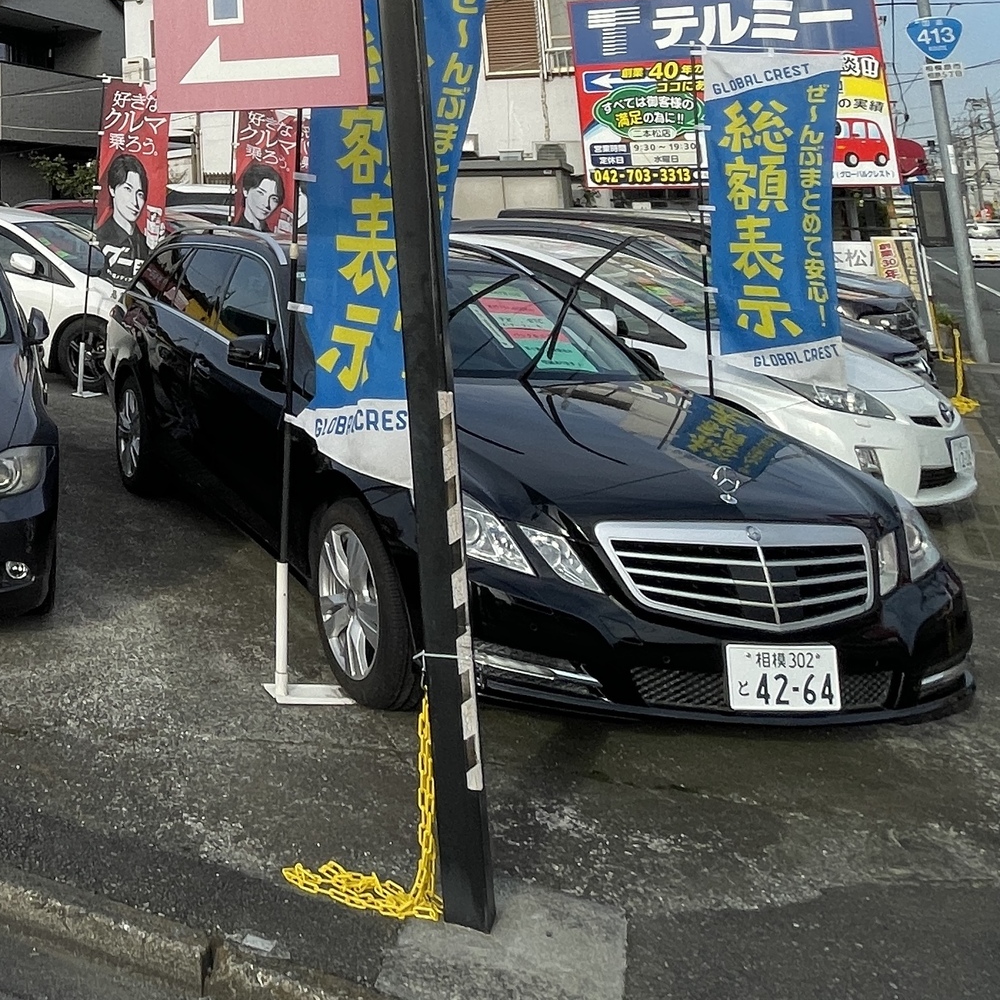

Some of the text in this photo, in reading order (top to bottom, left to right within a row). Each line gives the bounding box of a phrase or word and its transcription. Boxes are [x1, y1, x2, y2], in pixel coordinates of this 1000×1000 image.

[652, 0, 853, 50] テルミー
[917, 27, 956, 44] 413
[712, 63, 810, 95] GLOBAL CREST
[112, 91, 158, 112] 好きな
[602, 96, 694, 115] すべては御客様の
[104, 108, 168, 135] クルマ
[248, 111, 293, 137] 好きな
[109, 133, 158, 156] 乗ろう。
[240, 123, 296, 154] クルマ
[633, 129, 671, 138] 二本松店
[599, 155, 679, 165] 定休日 水曜日
[594, 168, 691, 183] 042-703-3313
[718, 99, 804, 339] 総額表示
[754, 344, 839, 367] GLOBAL CREST
[738, 673, 834, 705] と 42-64
